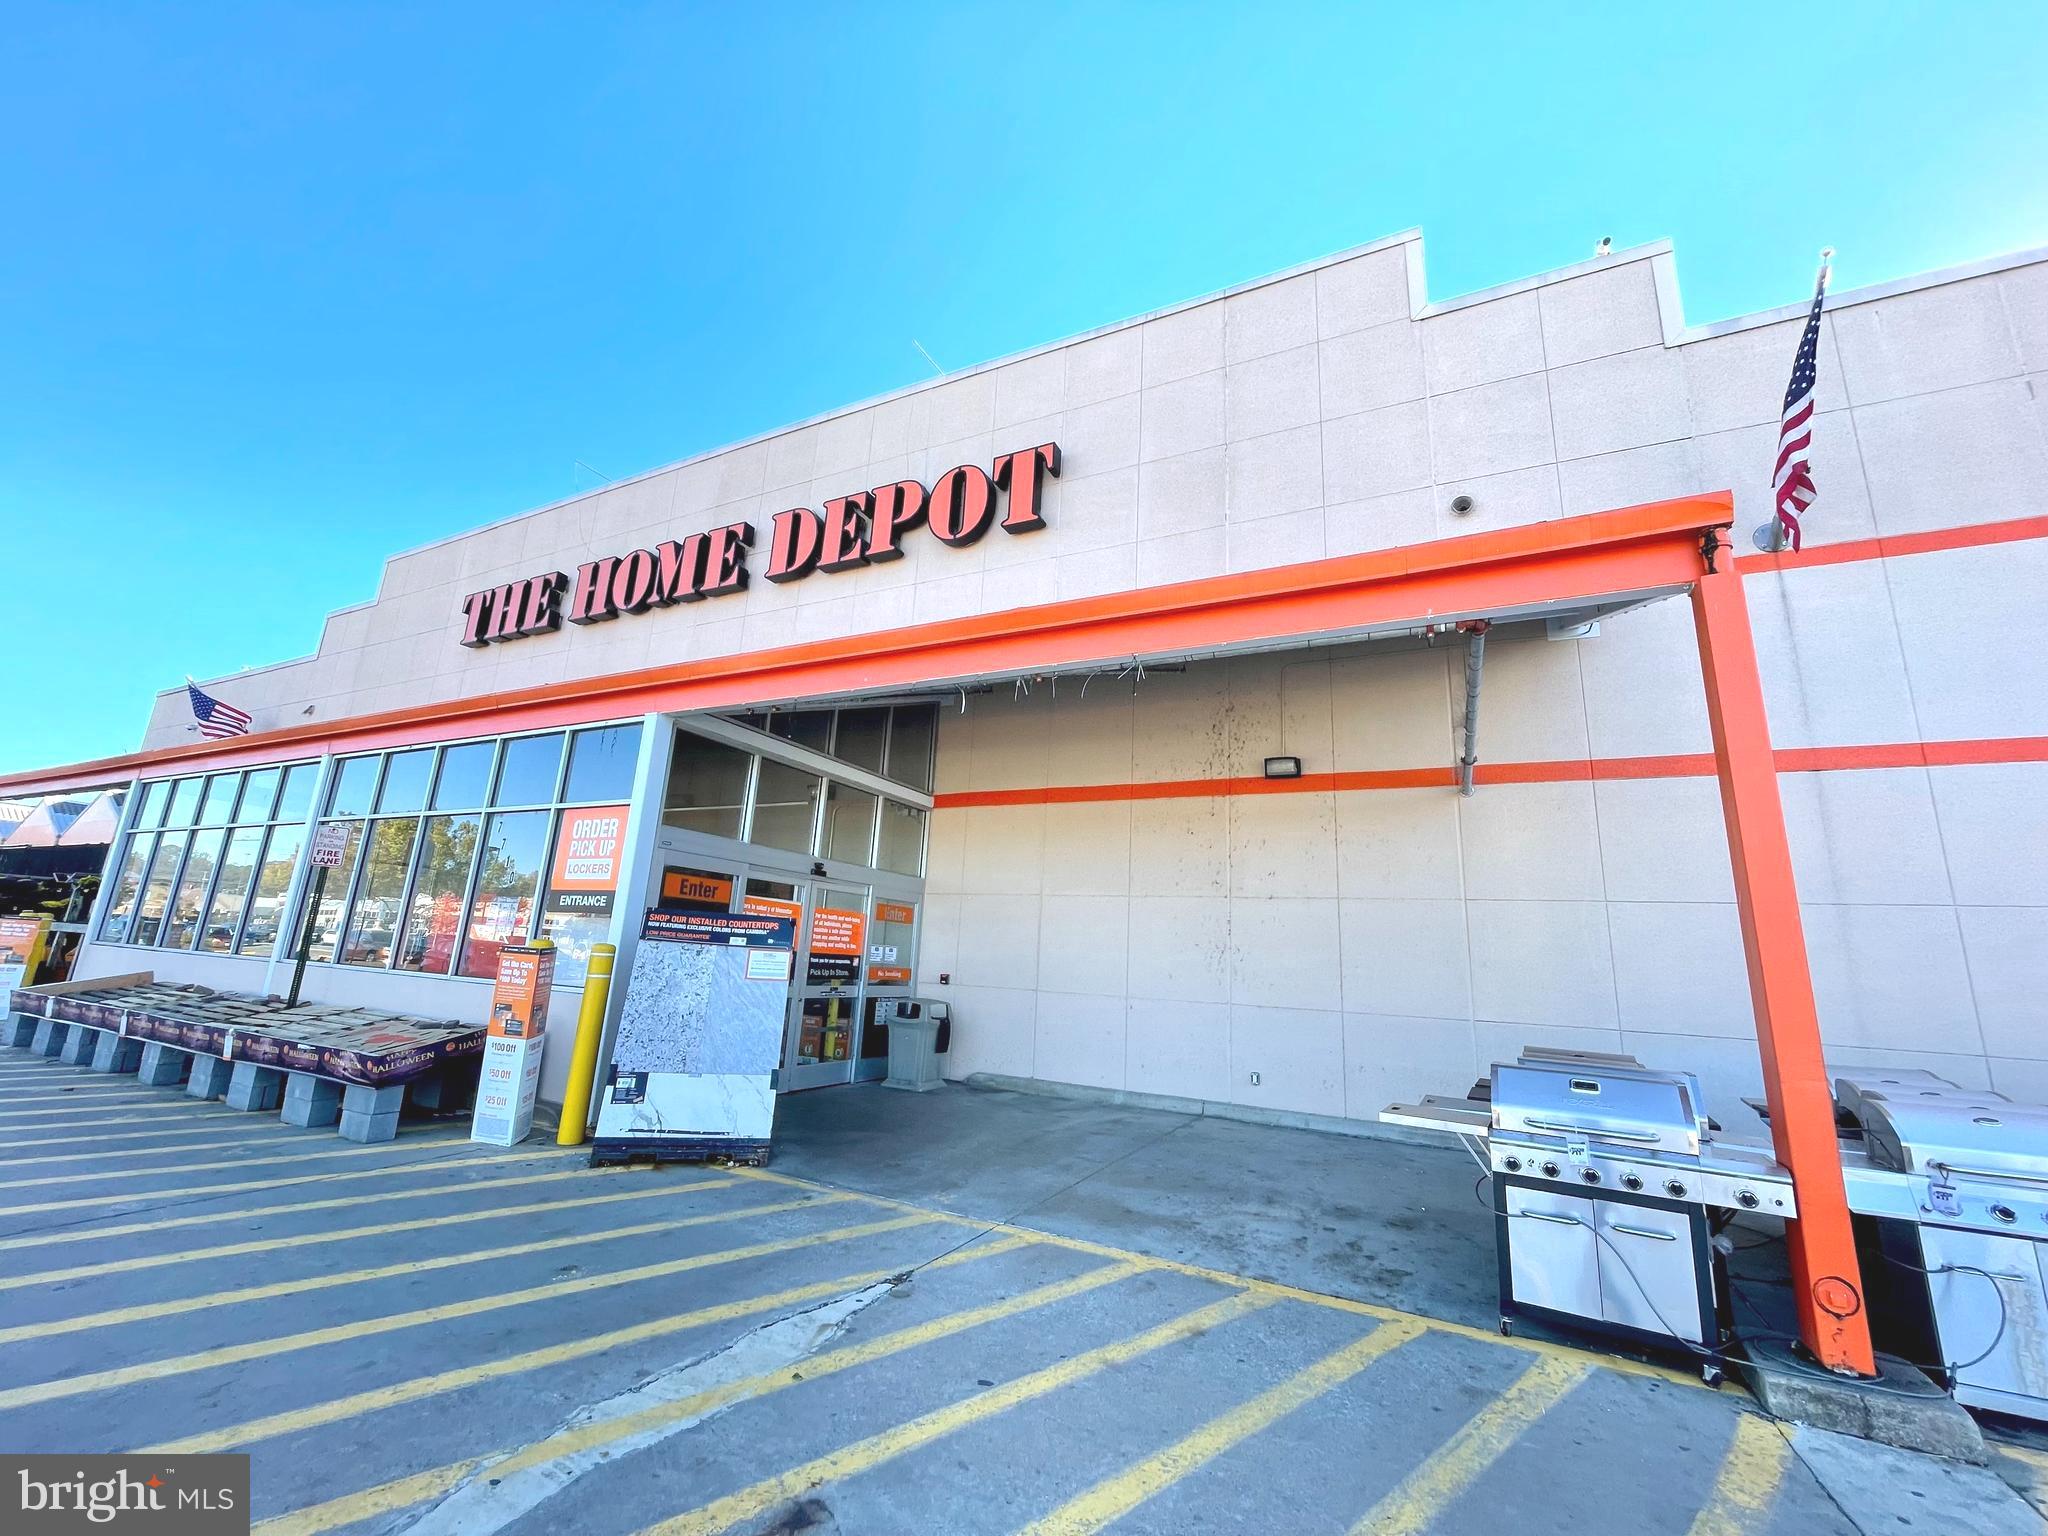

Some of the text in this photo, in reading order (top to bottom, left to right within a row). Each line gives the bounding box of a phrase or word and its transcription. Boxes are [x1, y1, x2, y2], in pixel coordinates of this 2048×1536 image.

[459, 441, 1062, 649] THE HOME DEPOT
[572, 818, 619, 839] ORDER
[316, 849, 340, 857] FIRE
[569, 839, 616, 857] PICK UP
[313, 856, 341, 864] LANE
[567, 863, 610, 874] LOCKERS
[680, 878, 719, 898] Enter
[559, 895, 607, 906] ENTRANCE
[884, 904, 907, 921] Enter
[649, 913, 779, 930] SHOP OUR INSTALLED COUNTERTOPS
[660, 922, 686, 930] FEATURING
[502, 959, 511, 967] Get
[511, 960, 520, 968] the
[501, 967, 513, 975] Save
[513, 968, 521, 976] Up
[884, 970, 902, 978] Smoking
[491, 1042, 505, 1051] $100
[505, 1043, 517, 1053] Off
[371, 1051, 435, 1073] HALLOWEEN
[489, 1068, 512, 1079] $50 Off
[485, 1095, 507, 1106] $25 Off
